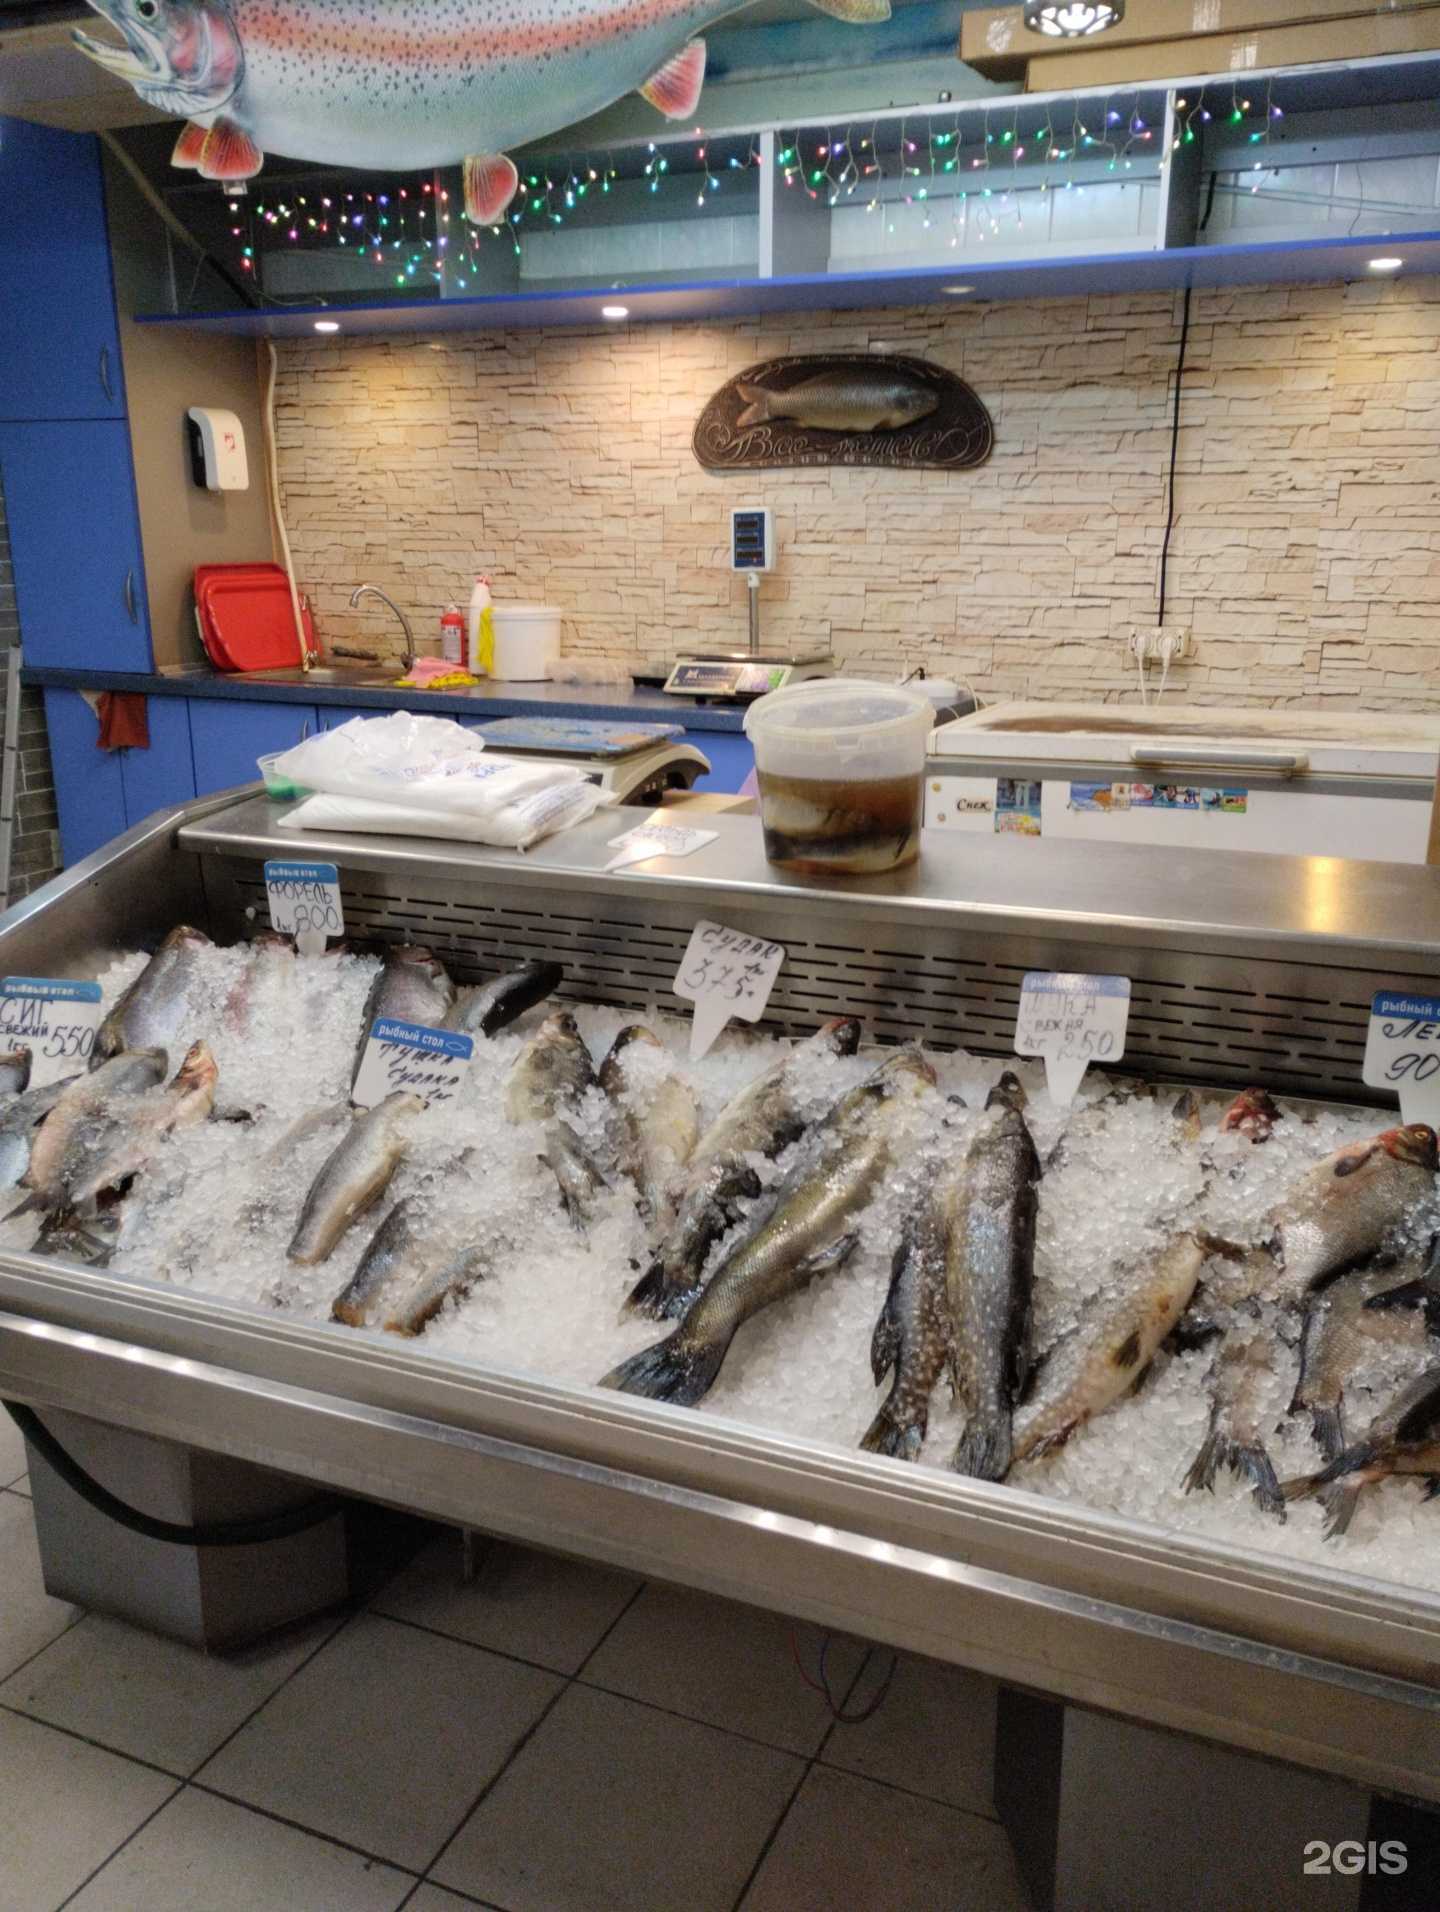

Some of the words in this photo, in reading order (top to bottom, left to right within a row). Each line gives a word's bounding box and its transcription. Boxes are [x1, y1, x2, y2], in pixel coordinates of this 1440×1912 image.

[268, 880, 333, 905] ФОРЕЛЬ
[1382, 1000, 1433, 1015] рыбный
[43, 1025, 95, 1058] 550
[378, 1025, 420, 1042] рыбный
[422, 1034, 444, 1049] стол
[1382, 1019, 1440, 1040] ЛЕ
